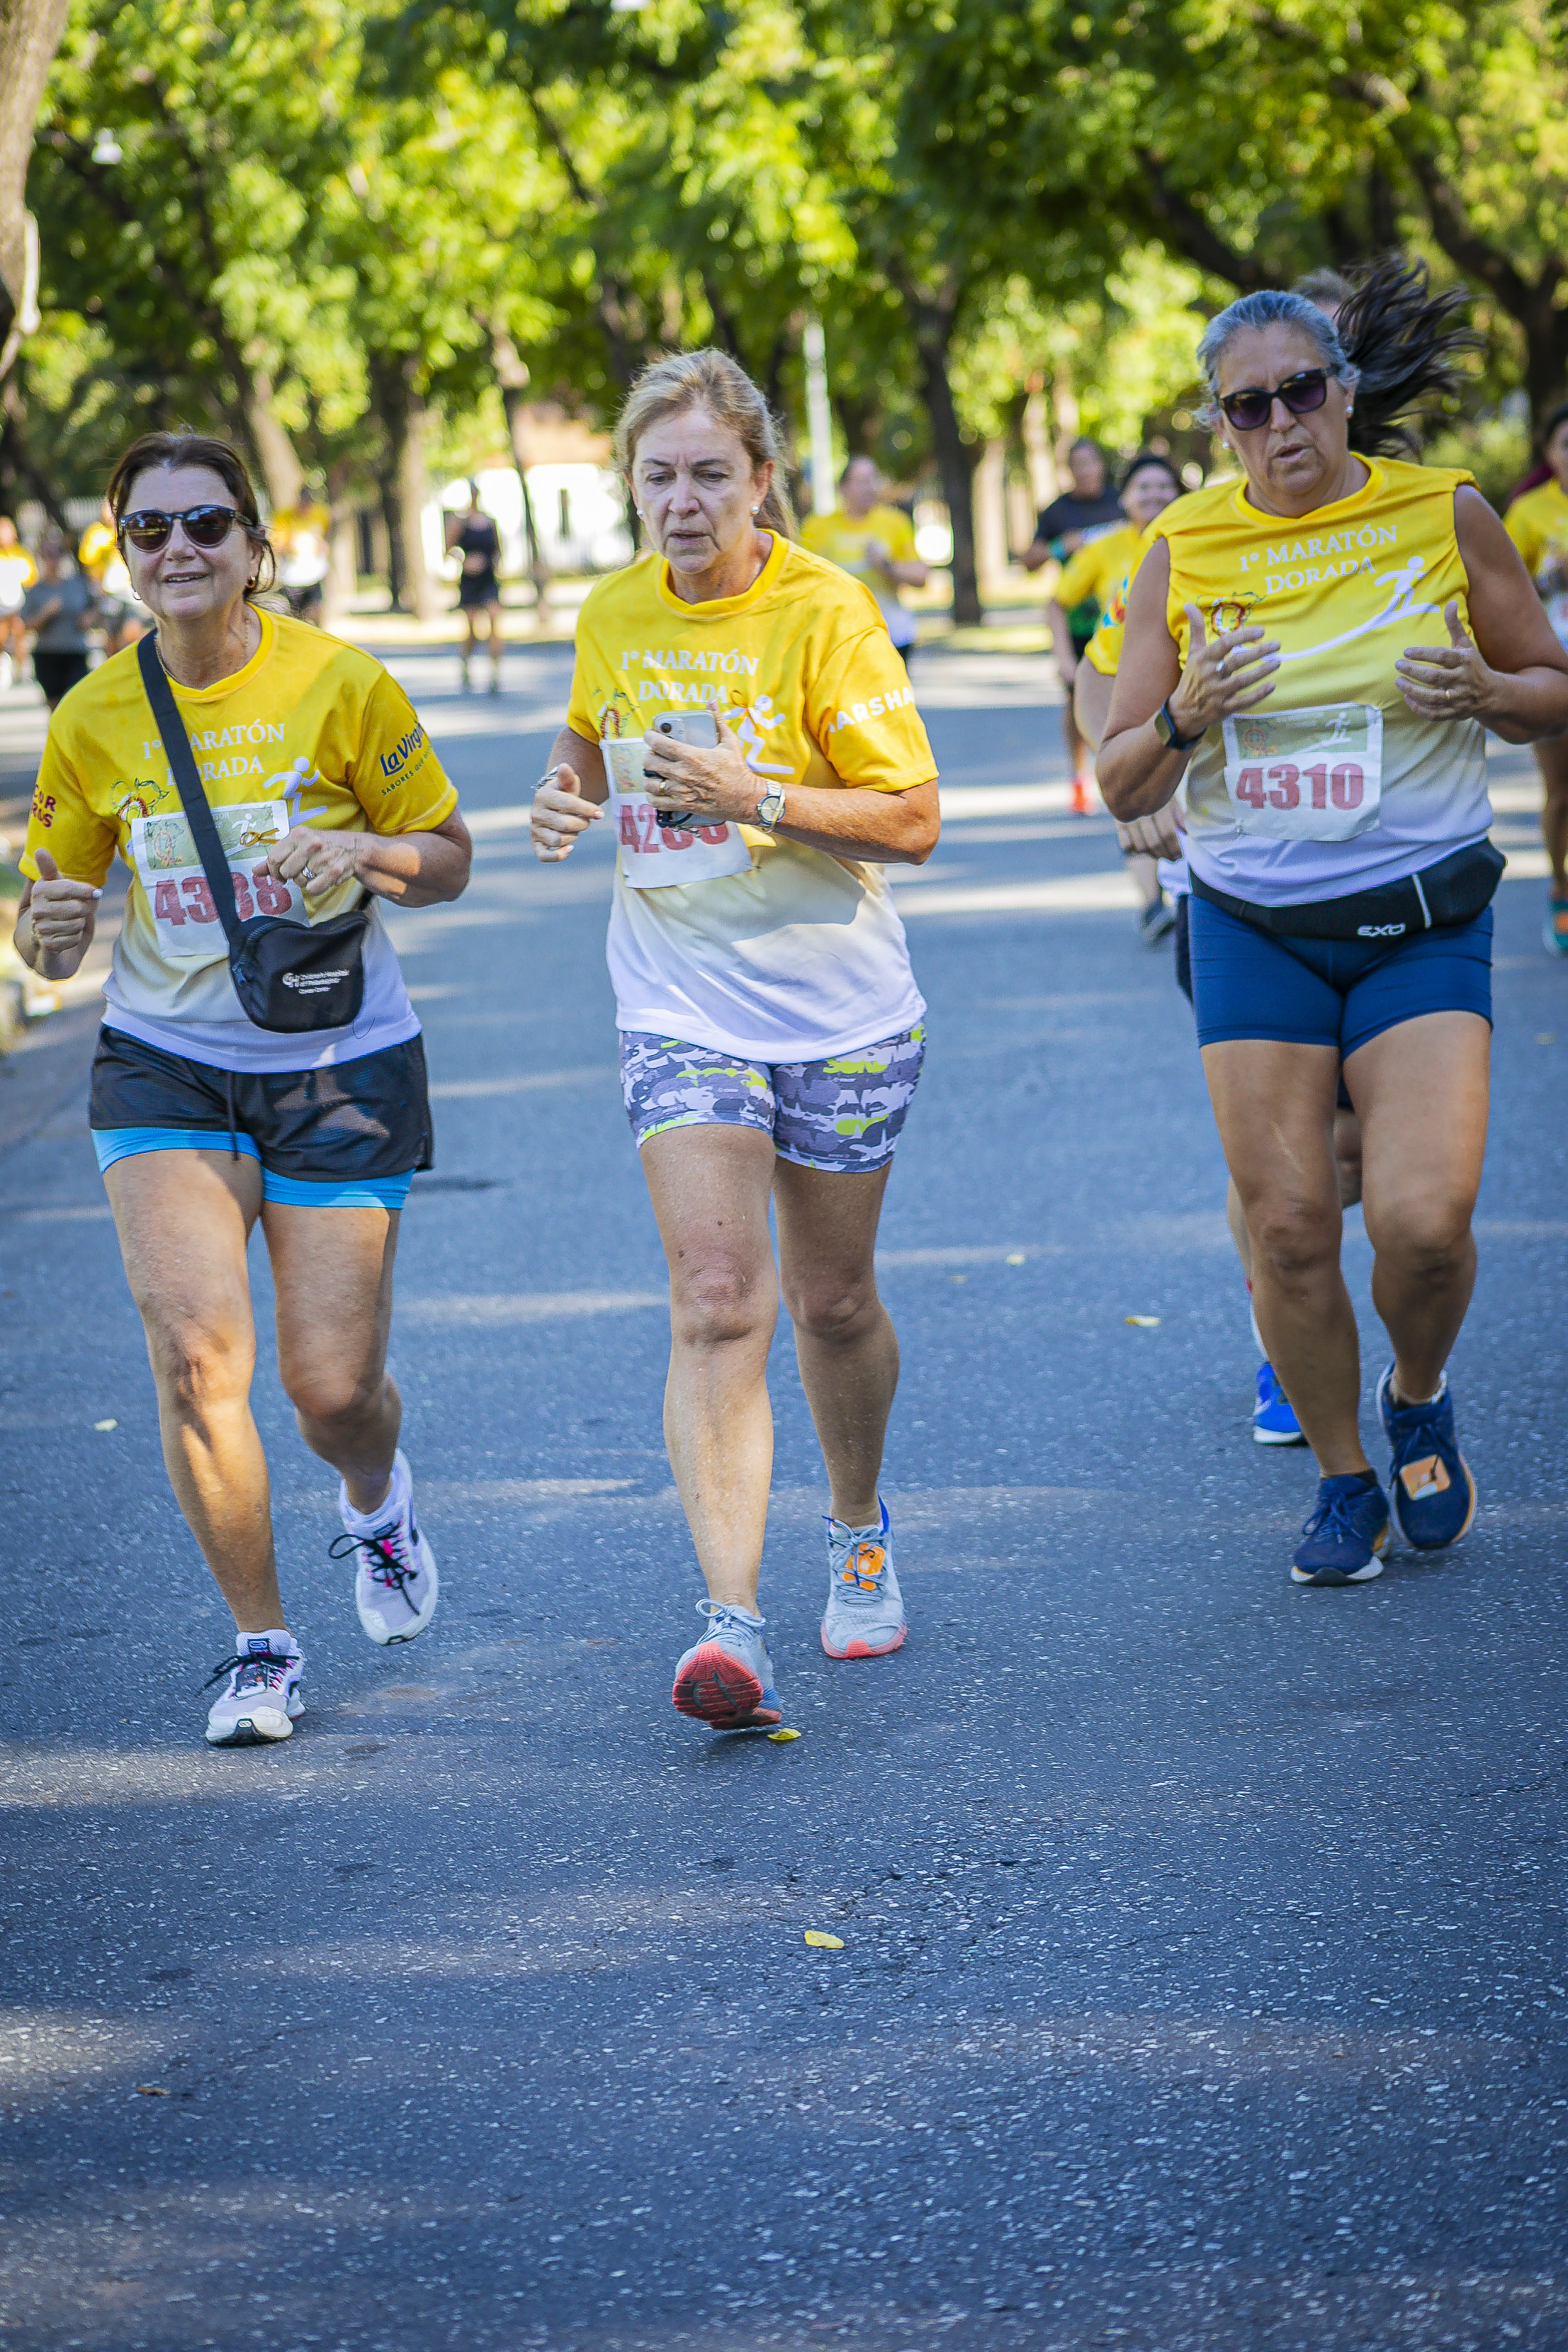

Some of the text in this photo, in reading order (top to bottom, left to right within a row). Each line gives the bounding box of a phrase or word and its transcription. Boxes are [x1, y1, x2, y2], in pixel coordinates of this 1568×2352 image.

[1266, 524, 1397, 566] MARATÓN
[1265, 556, 1377, 595] DORADA
[642, 648, 760, 676] MARATÓN
[638, 680, 728, 704] DORADA
[828, 686, 915, 733] ARSHA
[189, 719, 286, 752] ARATÓN
[167, 755, 265, 787] RADA
[381, 770, 414, 796] SABORES
[1236, 763, 1365, 810] 4310
